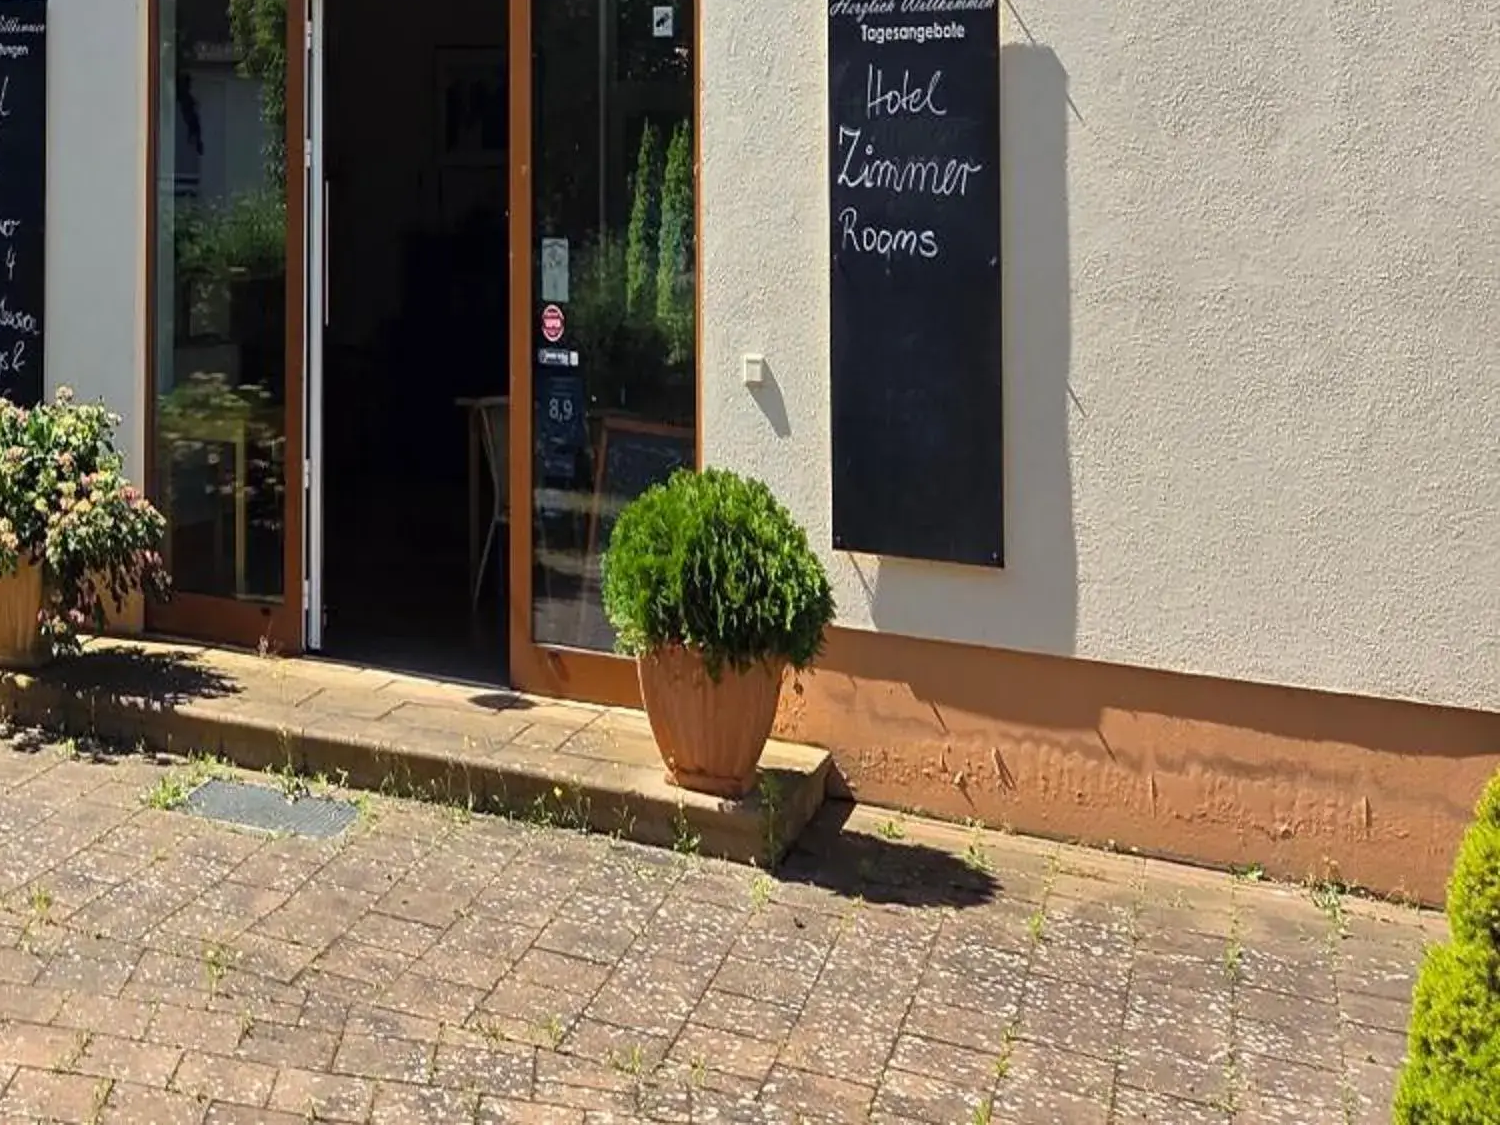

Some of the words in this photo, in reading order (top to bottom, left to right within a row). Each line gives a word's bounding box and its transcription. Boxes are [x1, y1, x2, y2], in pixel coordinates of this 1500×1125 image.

[860, 22, 966, 44] Tagesangebote
[867, 63, 948, 120] Hotel
[837, 126, 983, 196] Zimmer
[838, 207, 939, 258] Rooms
[6, 245, 17, 280] 4
[549, 398, 573, 423] 8,9
